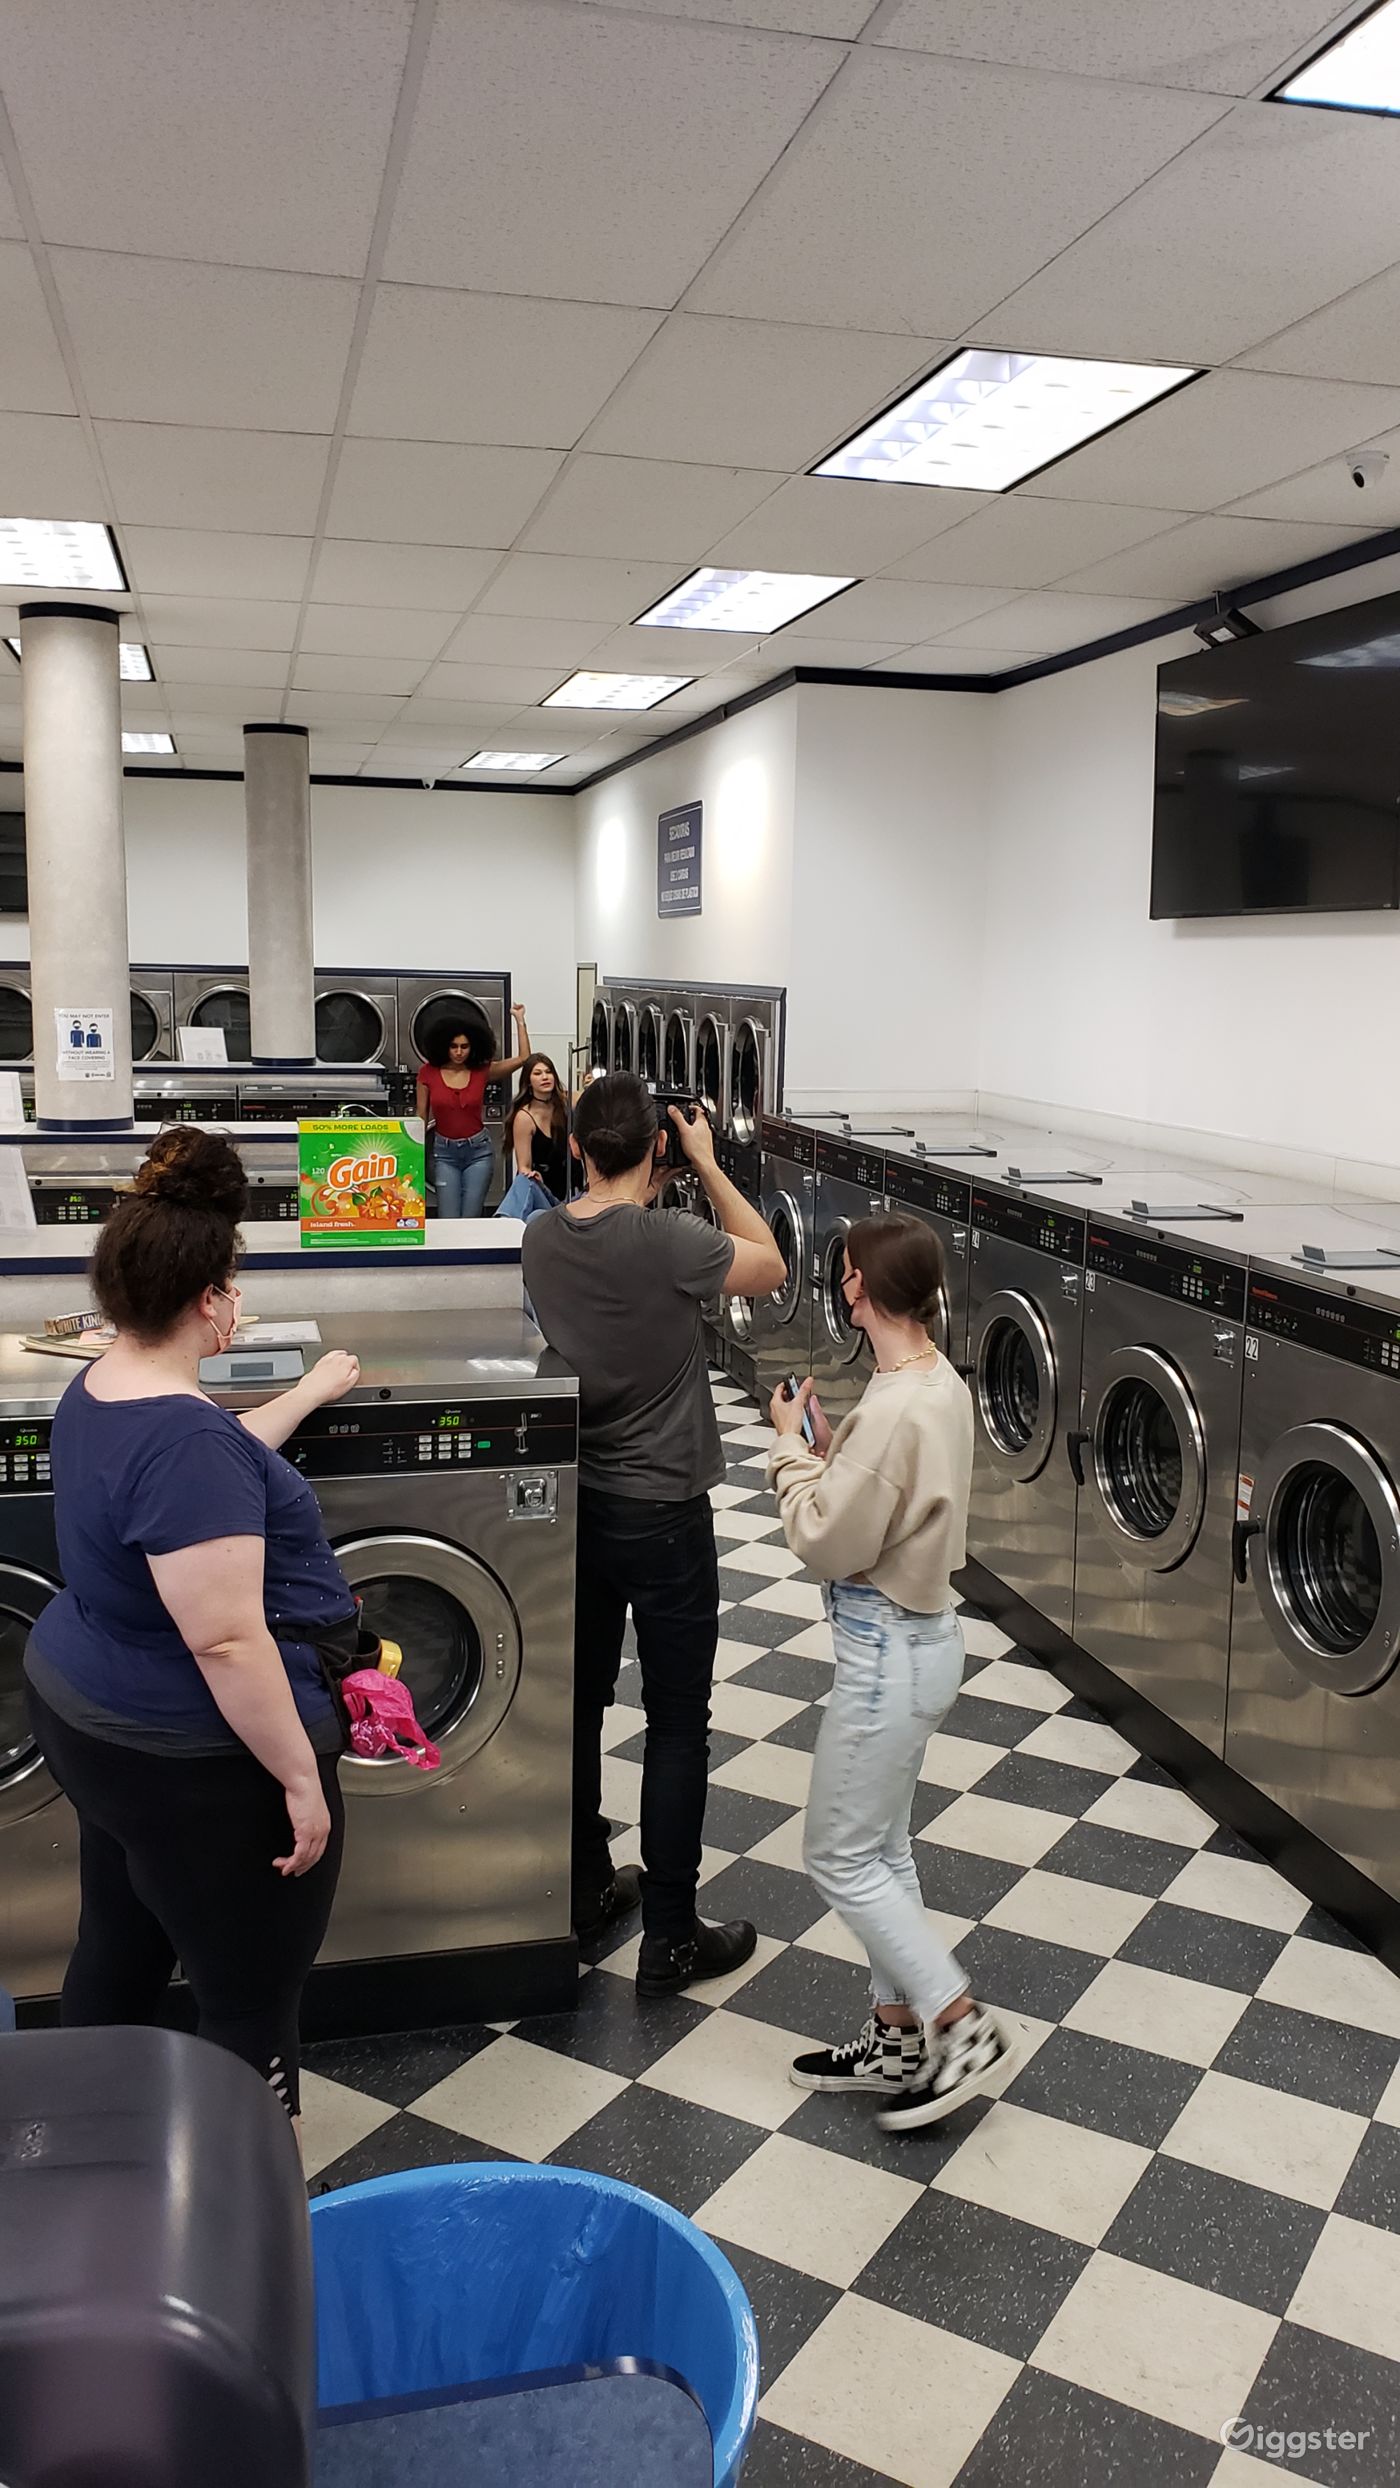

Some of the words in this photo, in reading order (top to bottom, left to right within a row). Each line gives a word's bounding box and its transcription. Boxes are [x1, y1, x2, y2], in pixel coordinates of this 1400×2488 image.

[360, 1123, 389, 1131] LOADS
[312, 1167, 325, 1175] 120
[328, 1153, 397, 1190] Gain
[1246, 1337, 1258, 1359] 22
[440, 1416, 460, 1426] 350
[15, 1435, 38, 1446] 350
